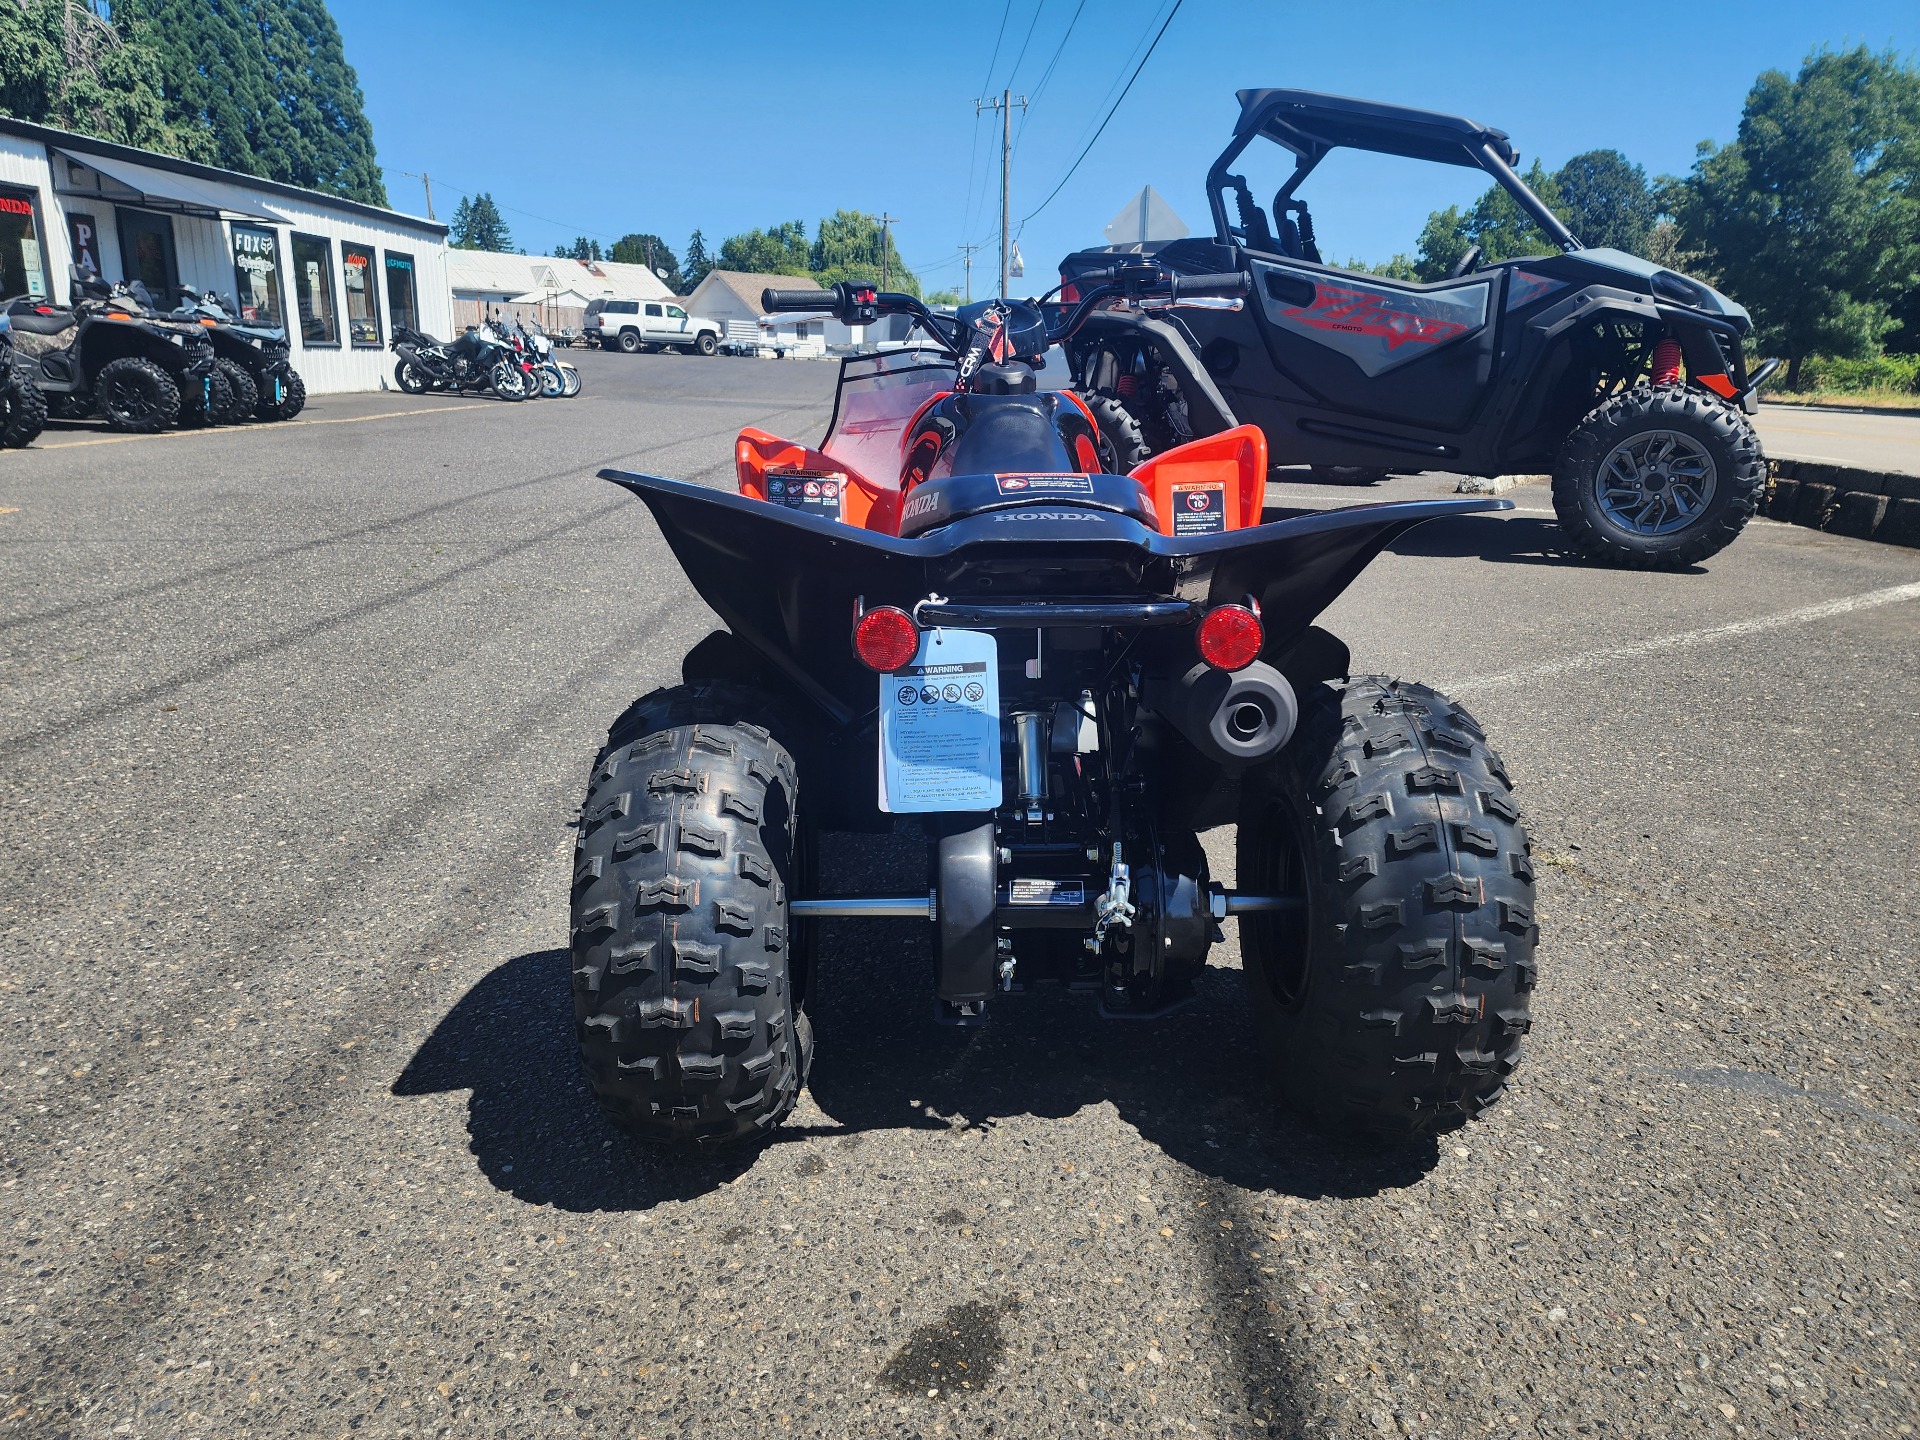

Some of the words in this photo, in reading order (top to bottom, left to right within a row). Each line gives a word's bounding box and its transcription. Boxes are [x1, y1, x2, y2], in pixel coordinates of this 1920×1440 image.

[235, 233, 260, 253] FOX
[1332, 323, 1363, 332] CFMOTO
[789, 469, 822, 477] WARNING
[1193, 500, 1203, 508] 10
[993, 512, 1106, 522] HONDA
[925, 664, 964, 674] WARNING
